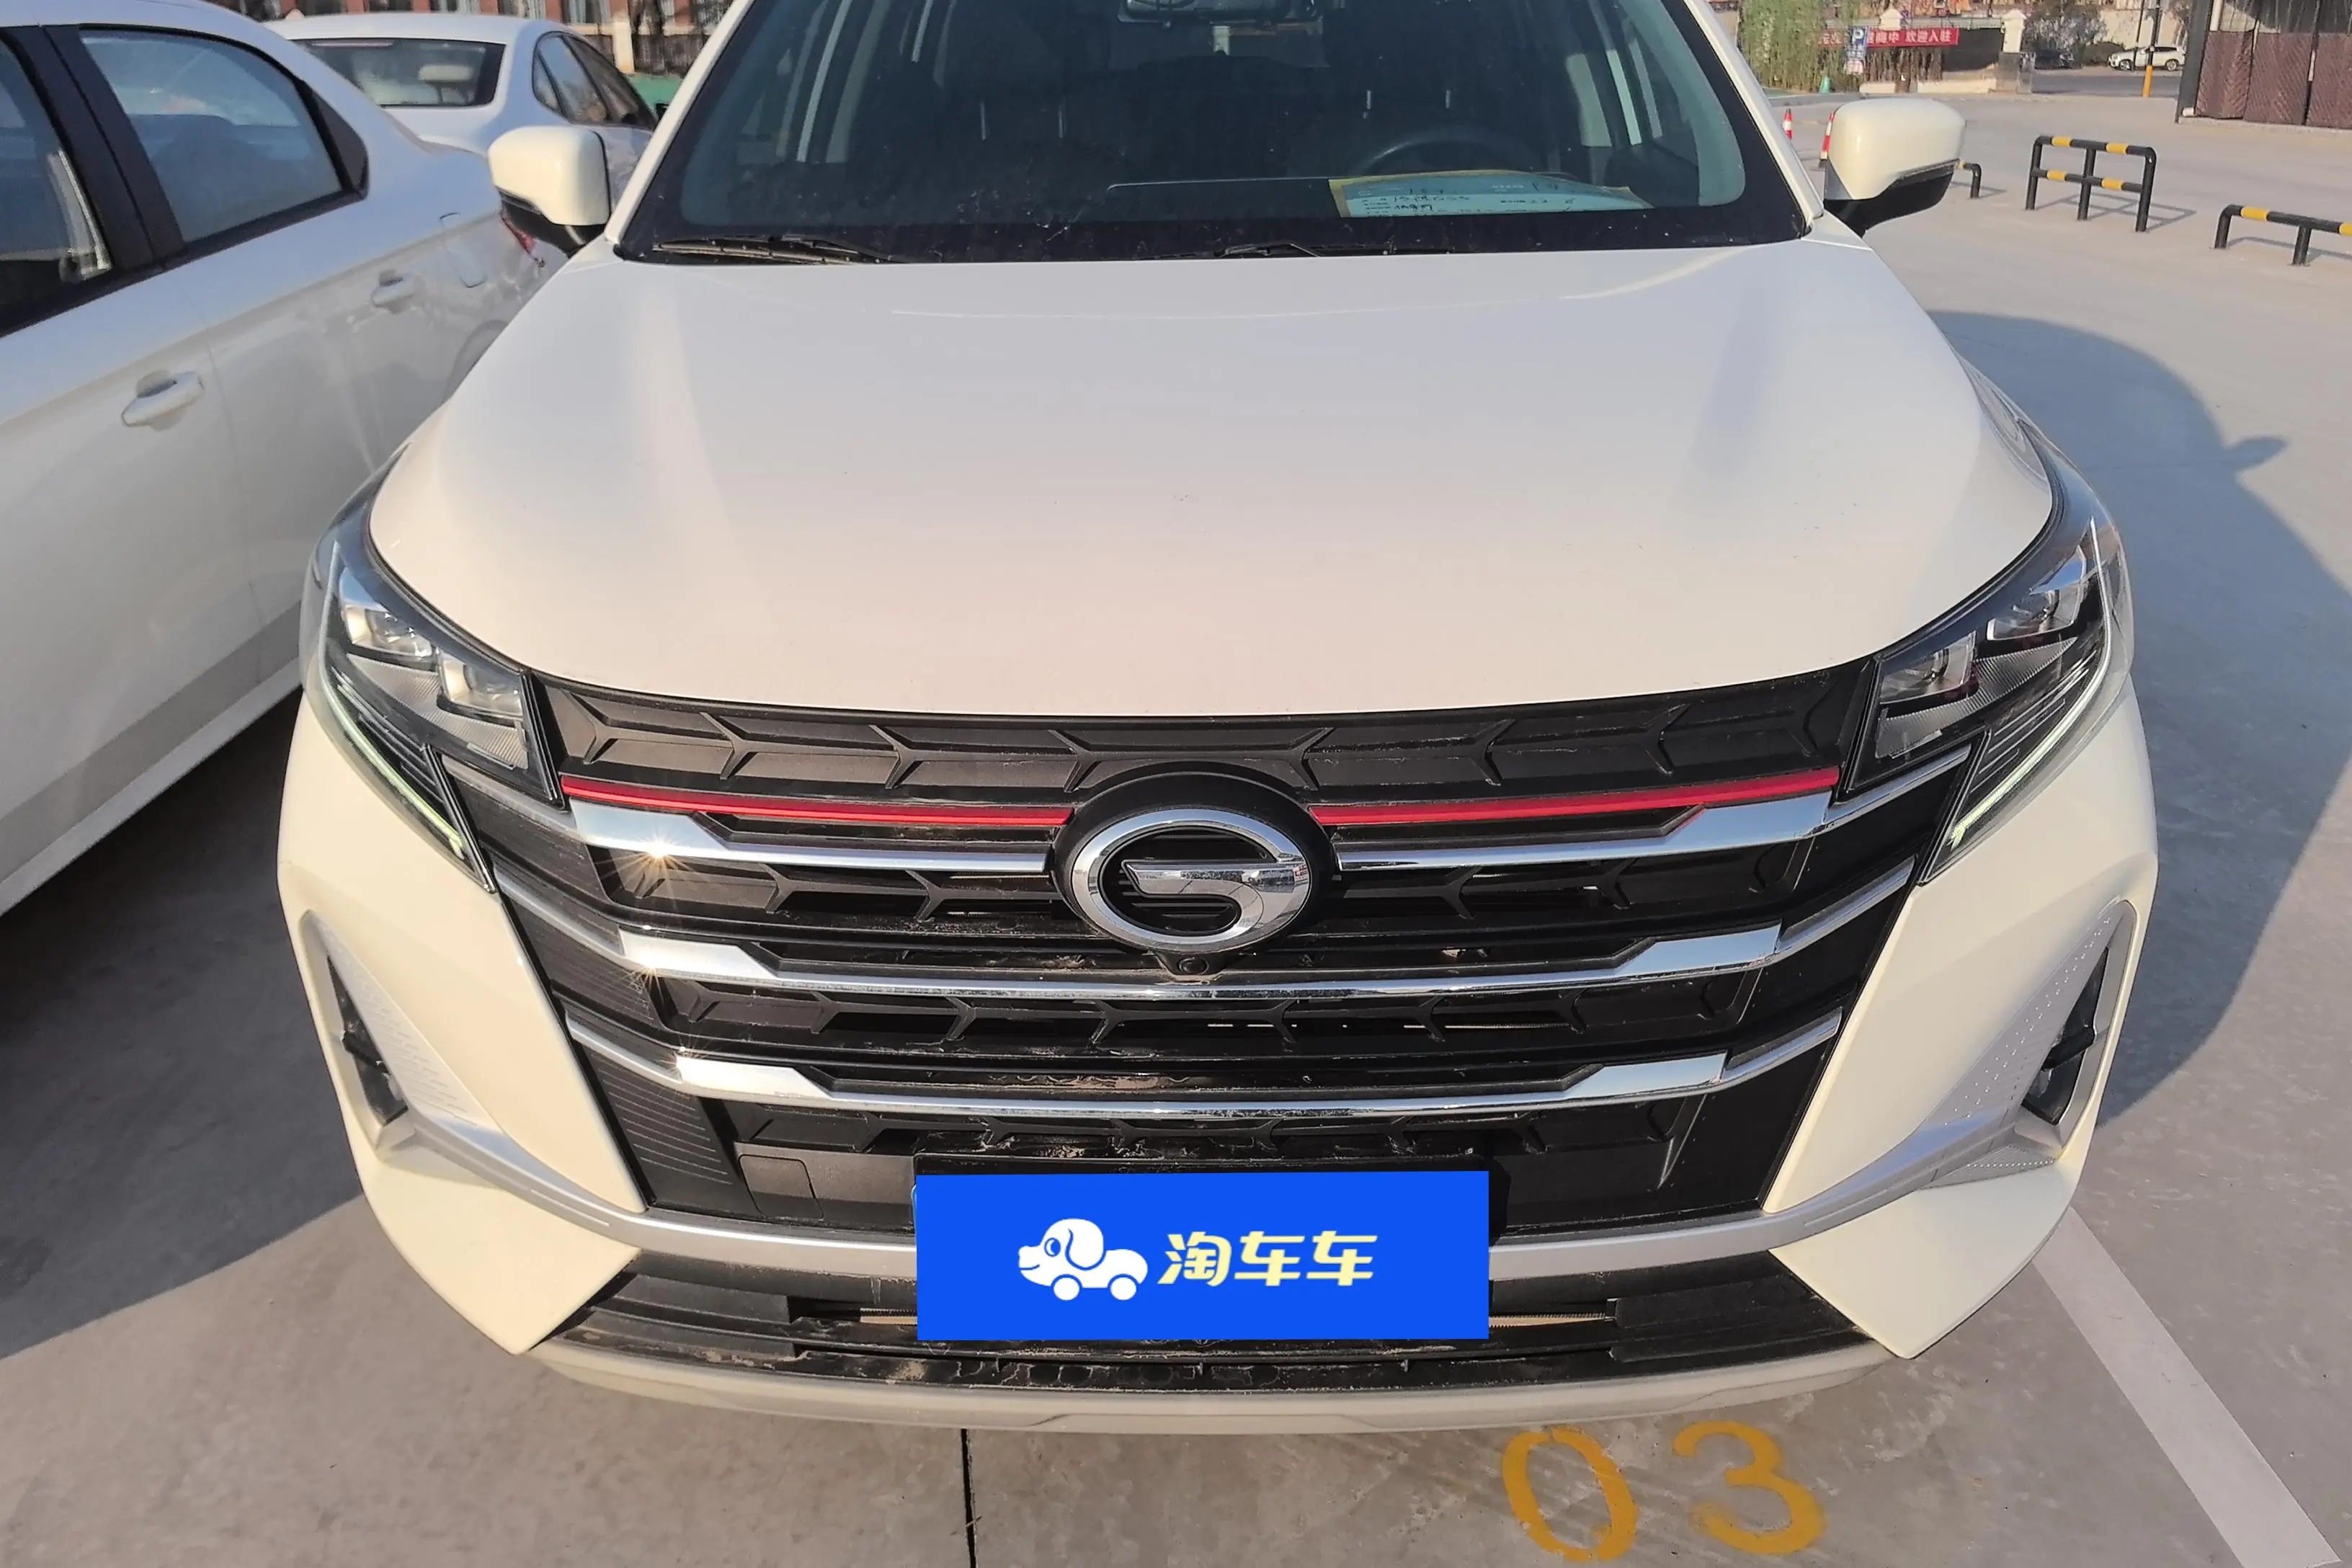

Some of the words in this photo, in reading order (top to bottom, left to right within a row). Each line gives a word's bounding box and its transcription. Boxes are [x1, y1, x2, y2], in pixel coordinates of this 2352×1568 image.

[1852, 28, 1864, 44] P
[1905, 29, 1951, 43] 欢迎入驻
